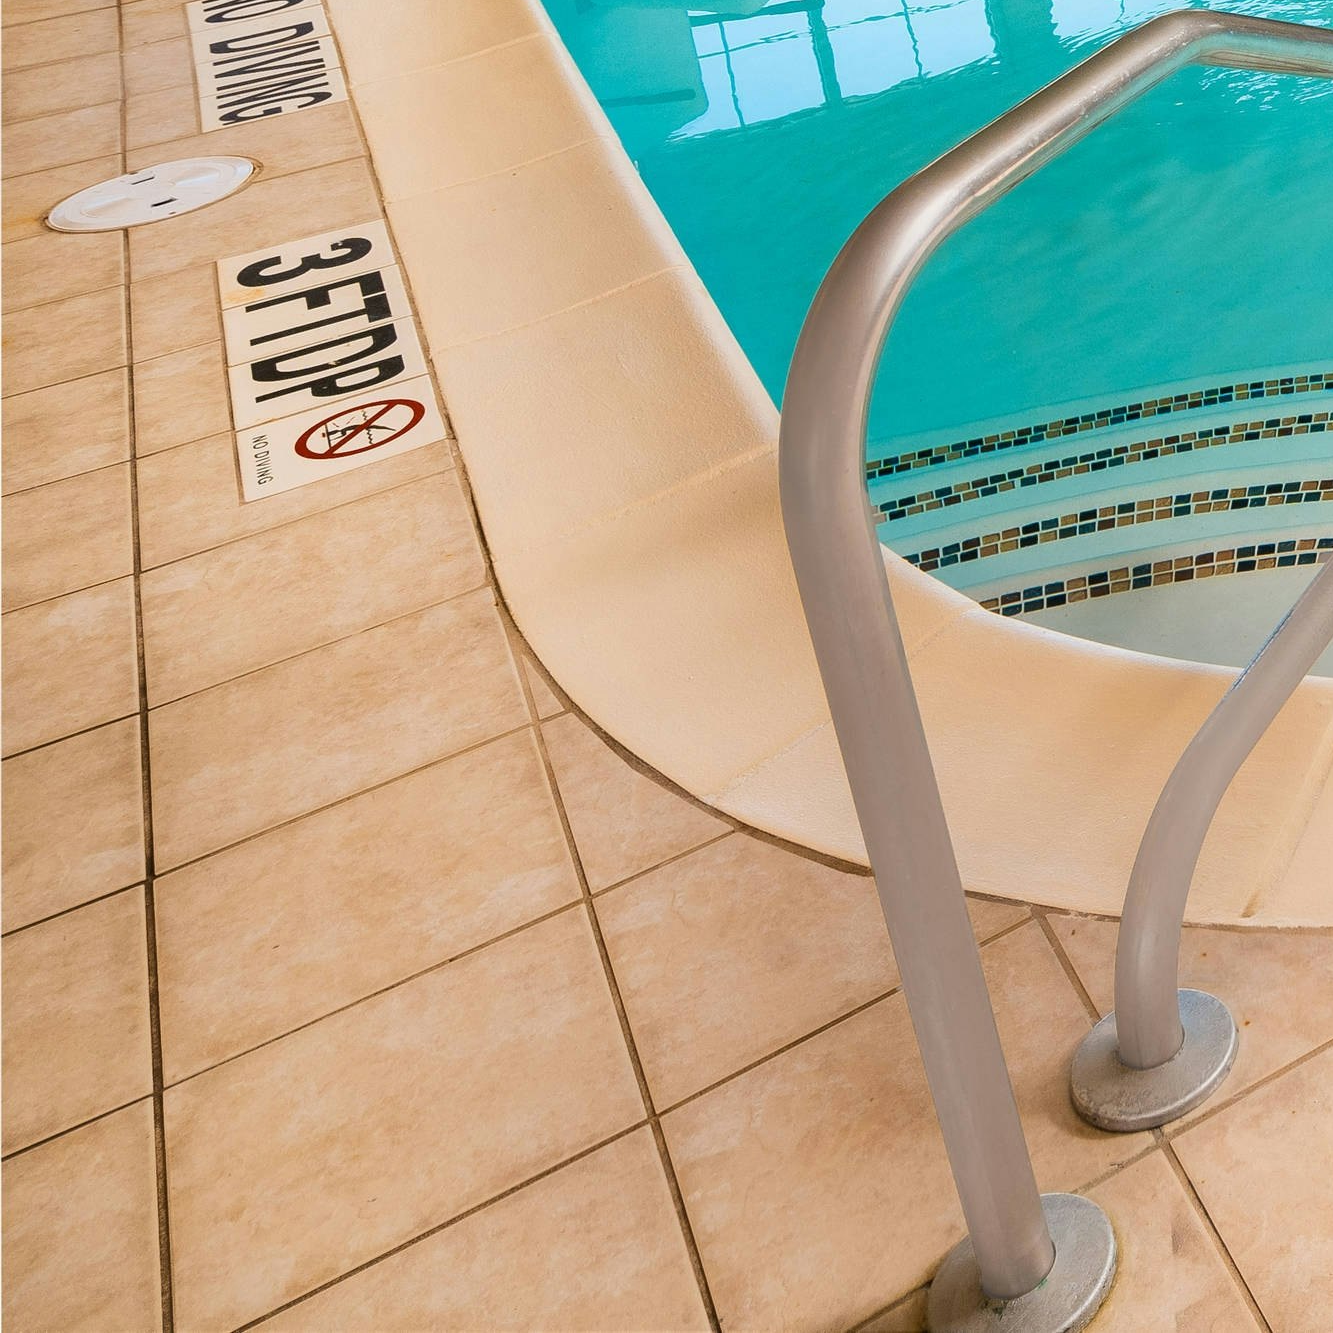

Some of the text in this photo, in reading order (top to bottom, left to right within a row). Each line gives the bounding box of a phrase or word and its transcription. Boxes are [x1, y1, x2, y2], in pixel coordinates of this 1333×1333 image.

[209, 21, 333, 126] DIVING
[236, 237, 373, 288] 3
[252, 434, 274, 485] NO DIVING
